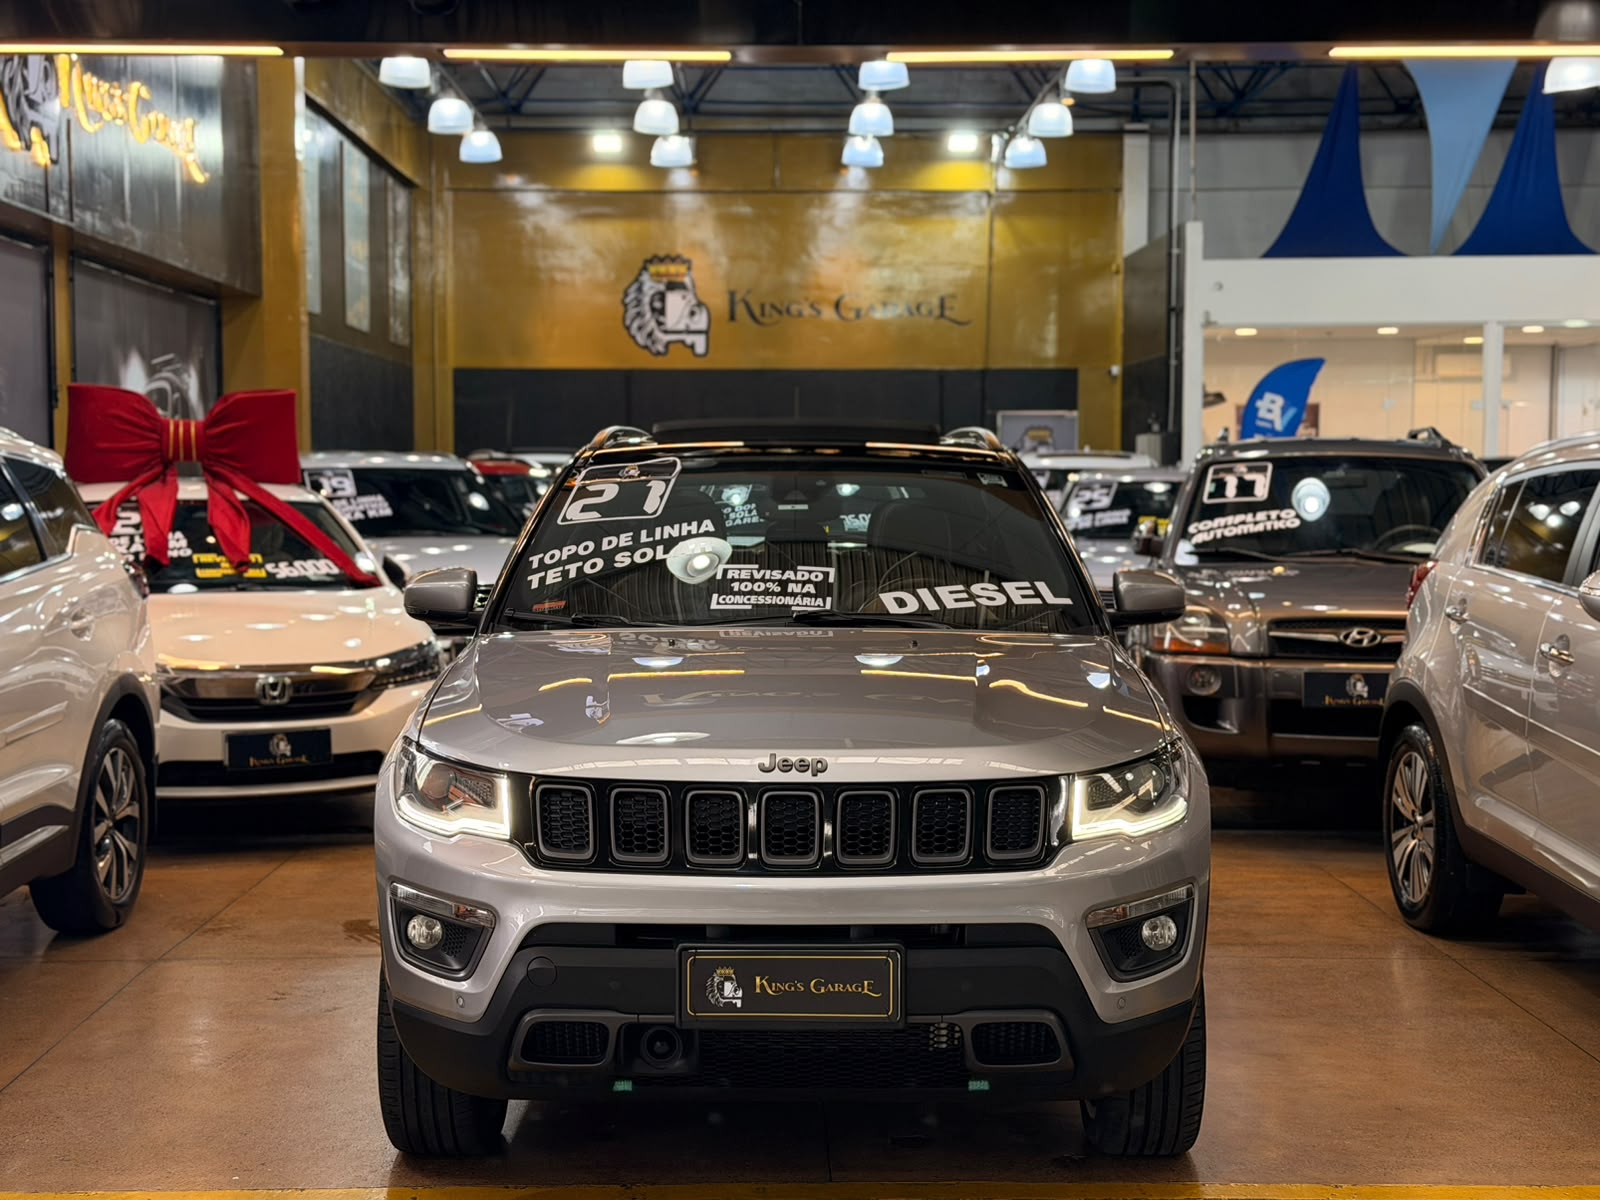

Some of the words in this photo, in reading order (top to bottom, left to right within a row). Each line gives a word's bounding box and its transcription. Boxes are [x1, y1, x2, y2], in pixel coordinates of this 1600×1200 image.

[834, 293, 973, 327] GARAGE
[565, 479, 667, 521] 21
[1188, 508, 1297, 534] COMPLETO
[528, 540, 595, 569] TOPO
[601, 532, 634, 551] DE
[639, 519, 715, 543] LINHA
[527, 557, 605, 590] TETO
[726, 569, 824, 582] REVISADO
[718, 594, 824, 607] CONCESSIONÁRIA
[730, 581, 782, 593] 100%
[787, 582, 816, 594] NA
[878, 581, 1074, 614] DIESEL
[757, 753, 829, 777] Jeep
[755, 975, 805, 996] KING'S
[810, 978, 883, 997] GARAGE
